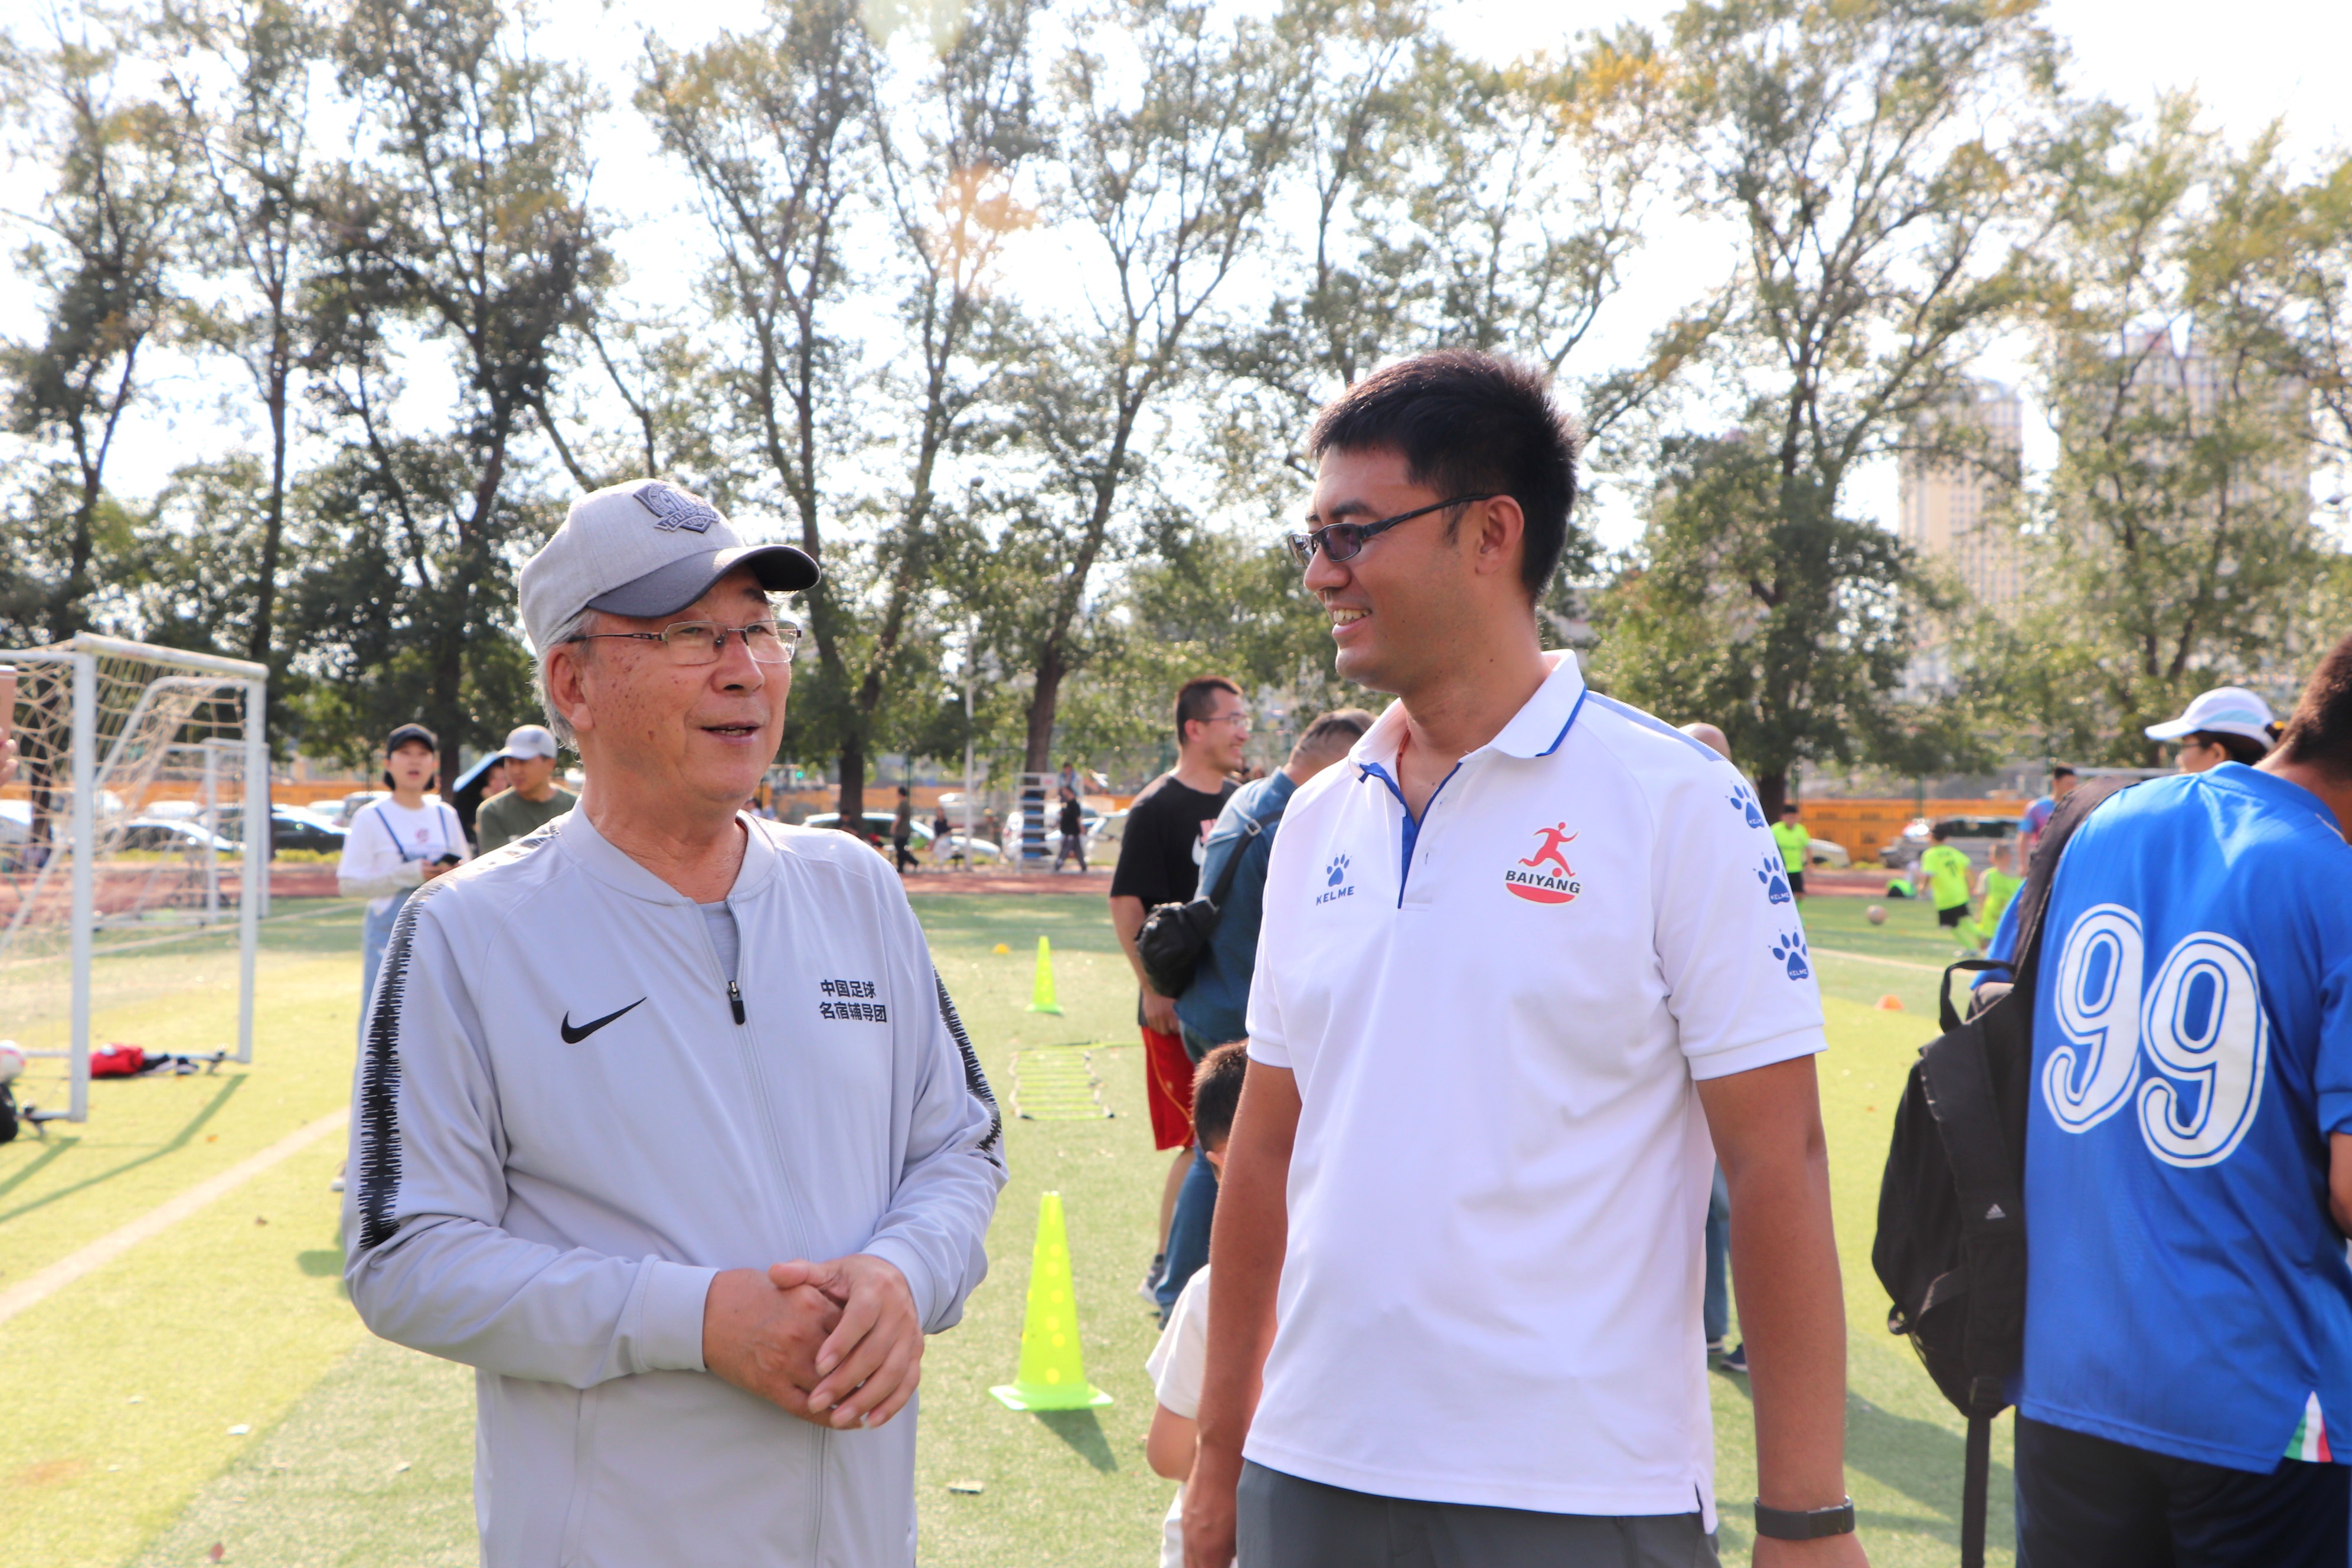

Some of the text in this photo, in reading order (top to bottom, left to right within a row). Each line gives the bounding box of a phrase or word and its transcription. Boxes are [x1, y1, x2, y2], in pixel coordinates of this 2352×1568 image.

[1505, 870, 1581, 893] BAIYANG
[1316, 886, 1355, 906] KELME
[820, 979, 876, 998] 中国足球
[819, 1002, 887, 1023] 名宿辅导团
[2041, 903, 2269, 1168] 99
